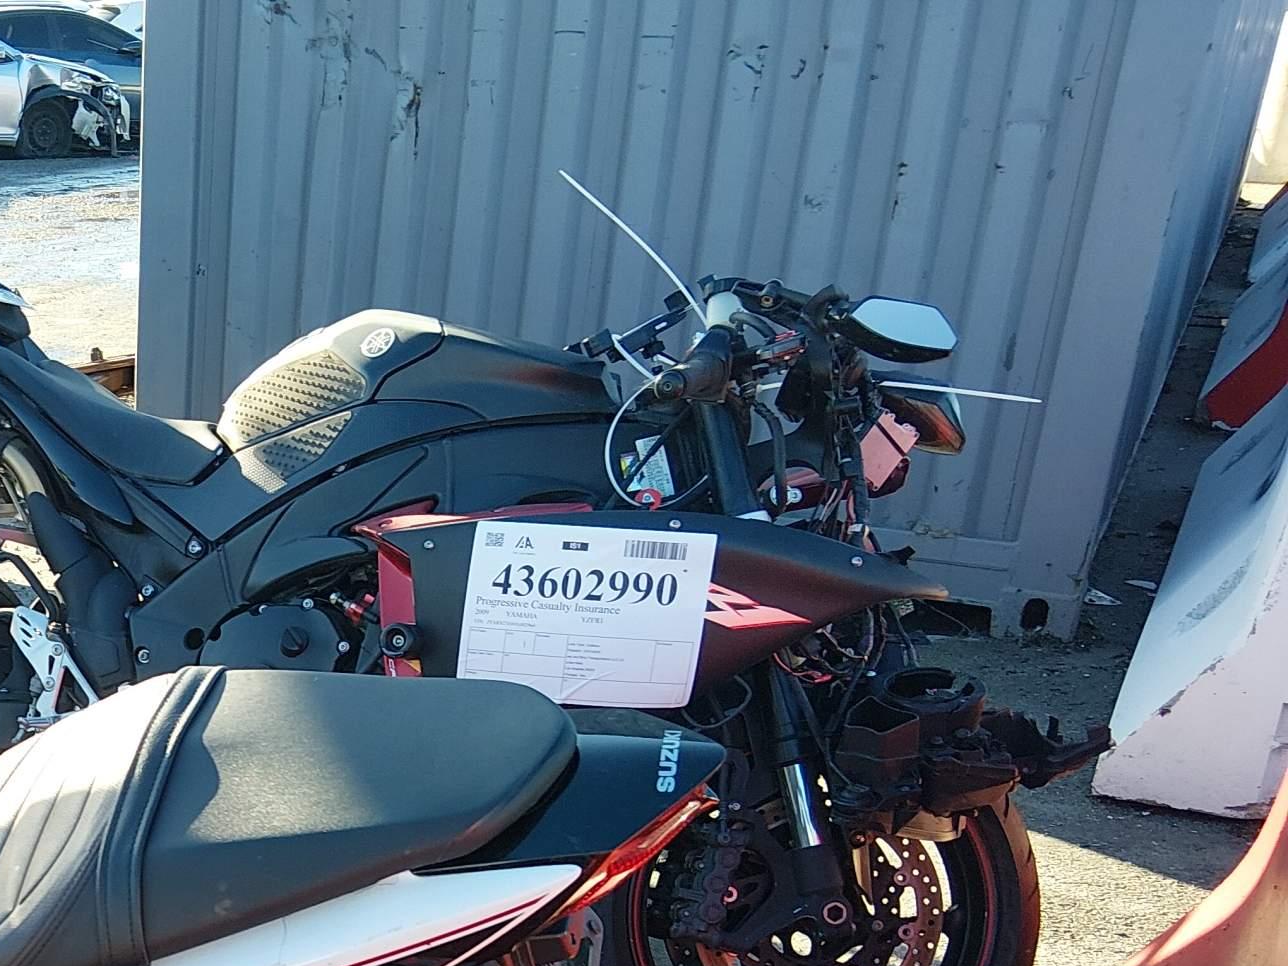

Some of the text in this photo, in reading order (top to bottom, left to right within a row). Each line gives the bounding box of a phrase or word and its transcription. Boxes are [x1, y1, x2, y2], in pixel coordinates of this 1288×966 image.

[492, 563, 678, 606] 43602990
[475, 595, 621, 615] Progressive Casualty Insurance
[506, 610, 538, 620] YAMAHA
[656, 729, 682, 793] SUZUKI
